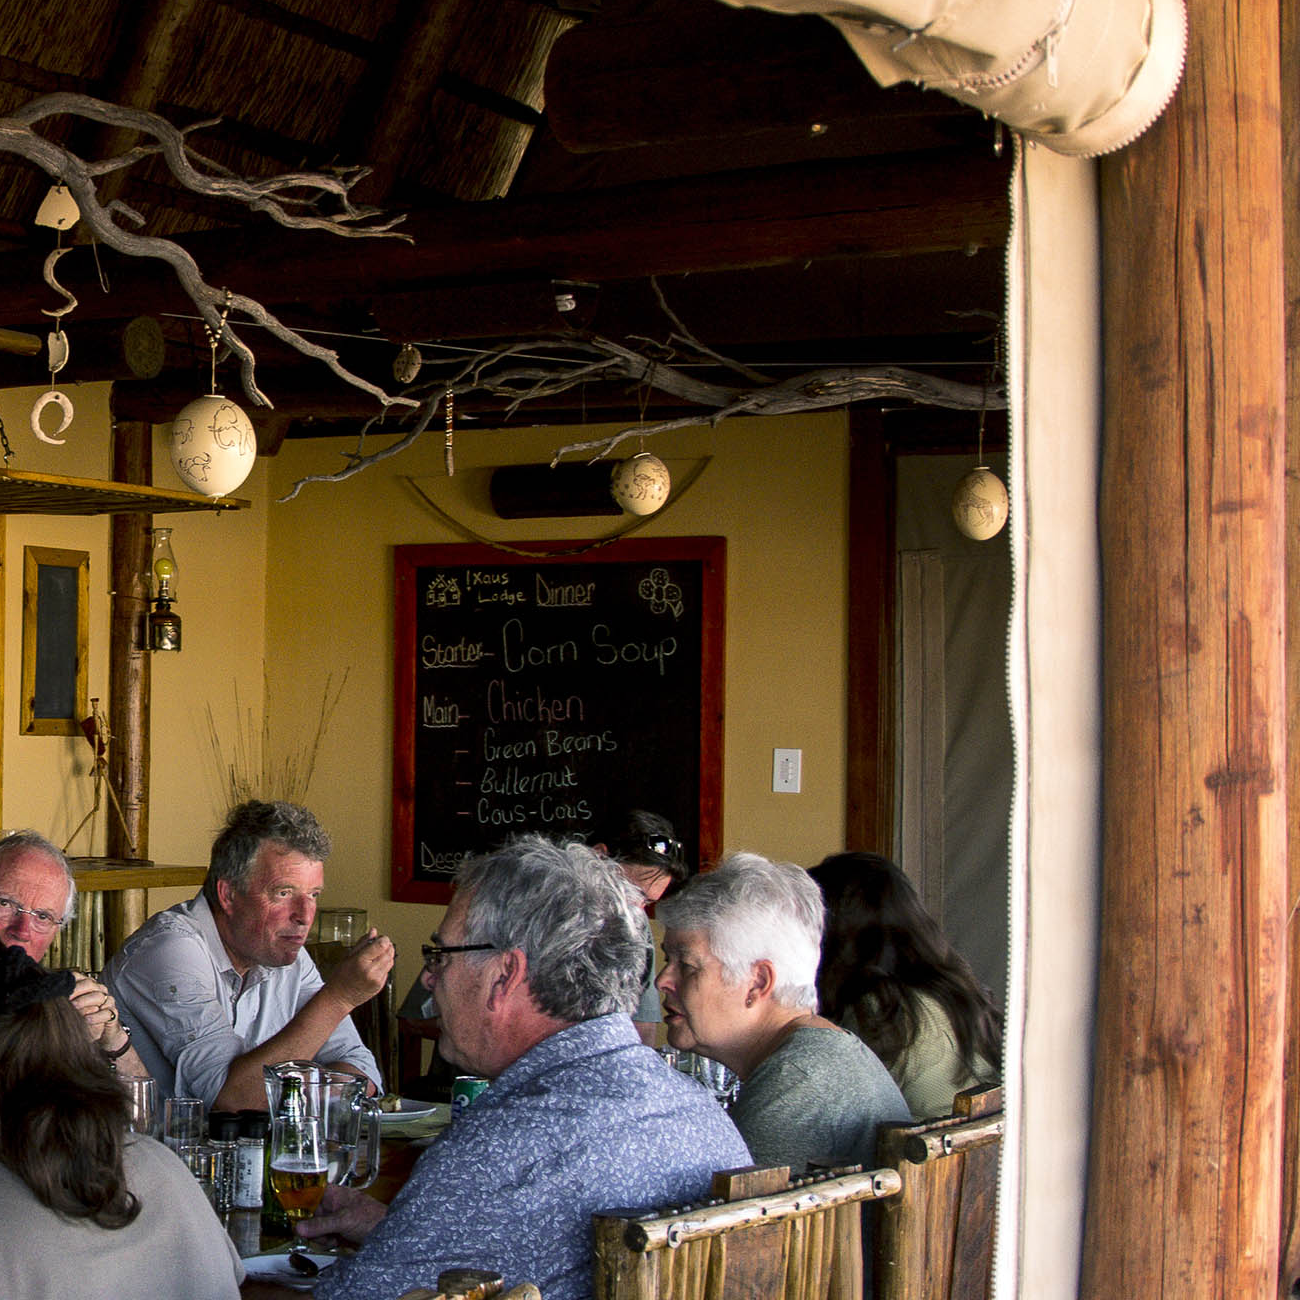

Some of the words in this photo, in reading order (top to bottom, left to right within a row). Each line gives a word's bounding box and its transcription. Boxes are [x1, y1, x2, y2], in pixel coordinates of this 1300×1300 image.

[478, 589, 527, 606] Lodge
[536, 573, 595, 605] Dinner
[502, 619, 578, 673] Corn
[592, 624, 677, 676] Soup
[487, 681, 584, 725] Chicken
[484, 727, 537, 761] Green
[546, 731, 617, 757] Beans
[477, 796, 593, 825] Cous-Cous
